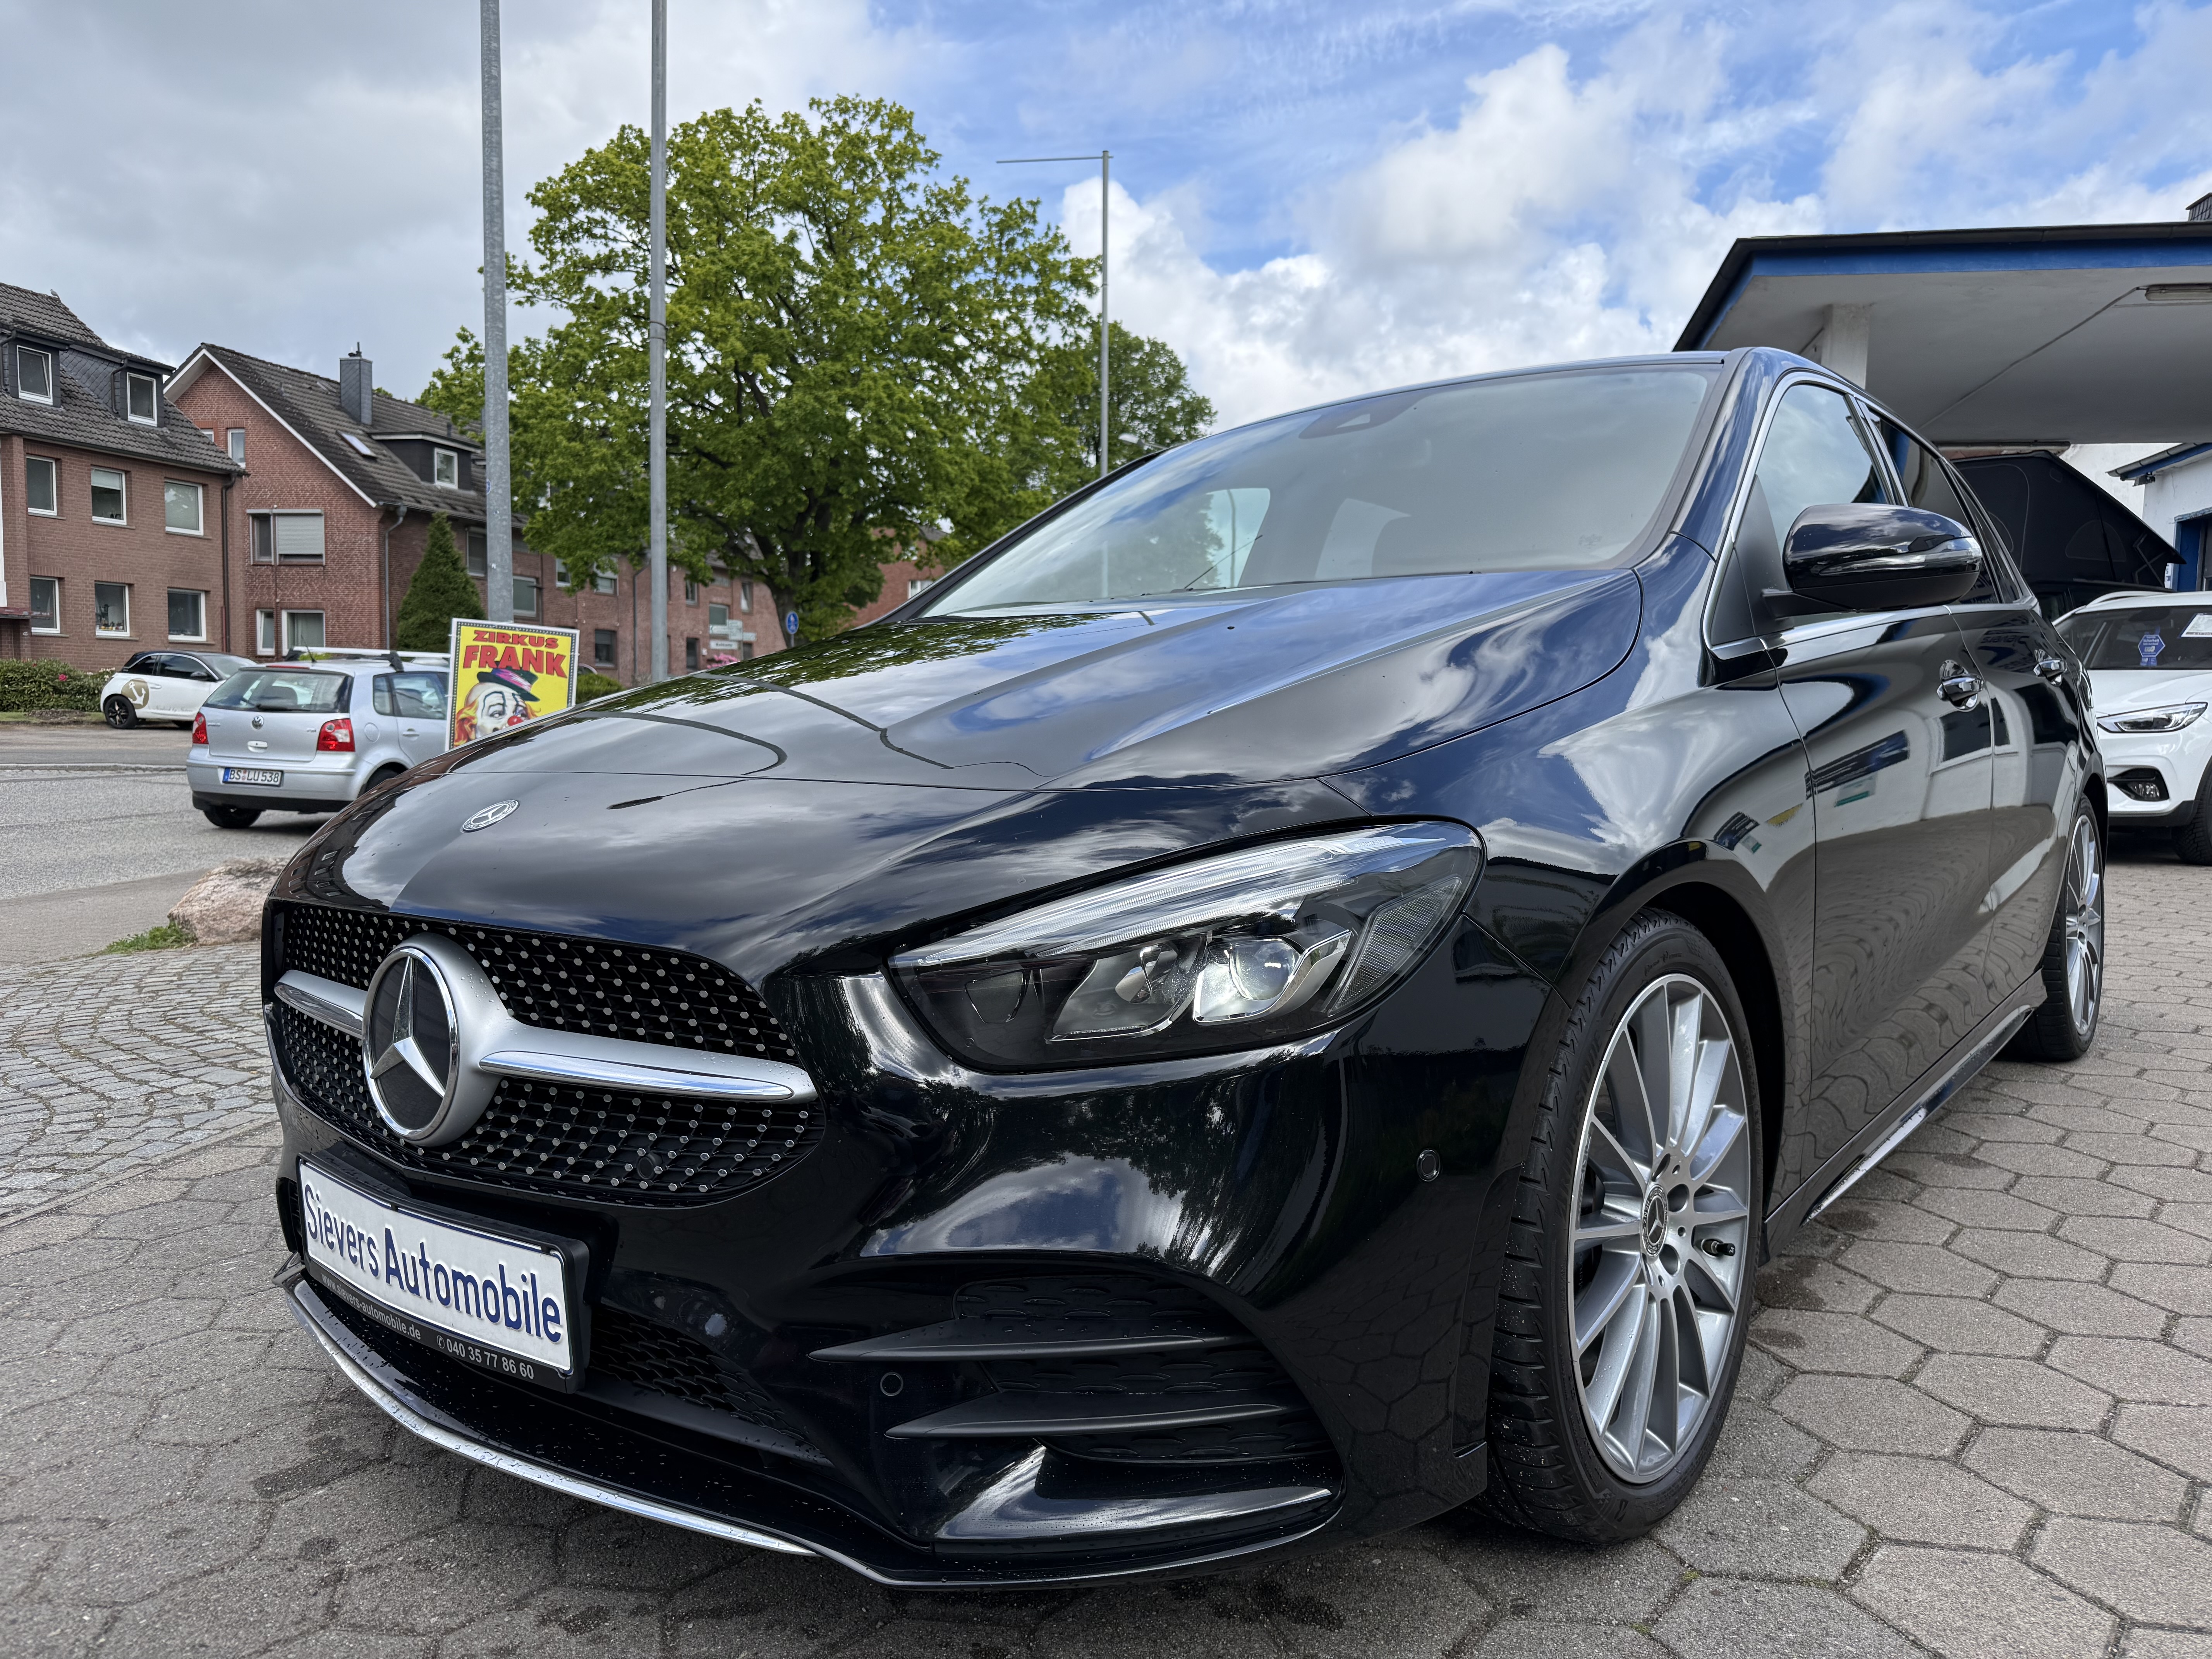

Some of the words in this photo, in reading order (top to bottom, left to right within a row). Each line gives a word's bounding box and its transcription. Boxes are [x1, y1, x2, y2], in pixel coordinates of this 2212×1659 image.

[472, 630, 559, 649] ZIRKUS
[463, 645, 567, 678] FRANK
[229, 769, 242, 780] BS
[247, 770, 260, 781] LU
[261, 771, 279, 783] 538
[304, 1183, 380, 1277] Sievers
[385, 1227, 561, 1343] Automobile
[321, 1273, 421, 1340] www.sievers-automobile.de
[446, 1338, 465, 1357] 040
[468, 1346, 482, 1363] 35
[484, 1352, 498, 1368] 77
[502, 1357, 517, 1374] 86
[519, 1362, 534, 1379] 60
